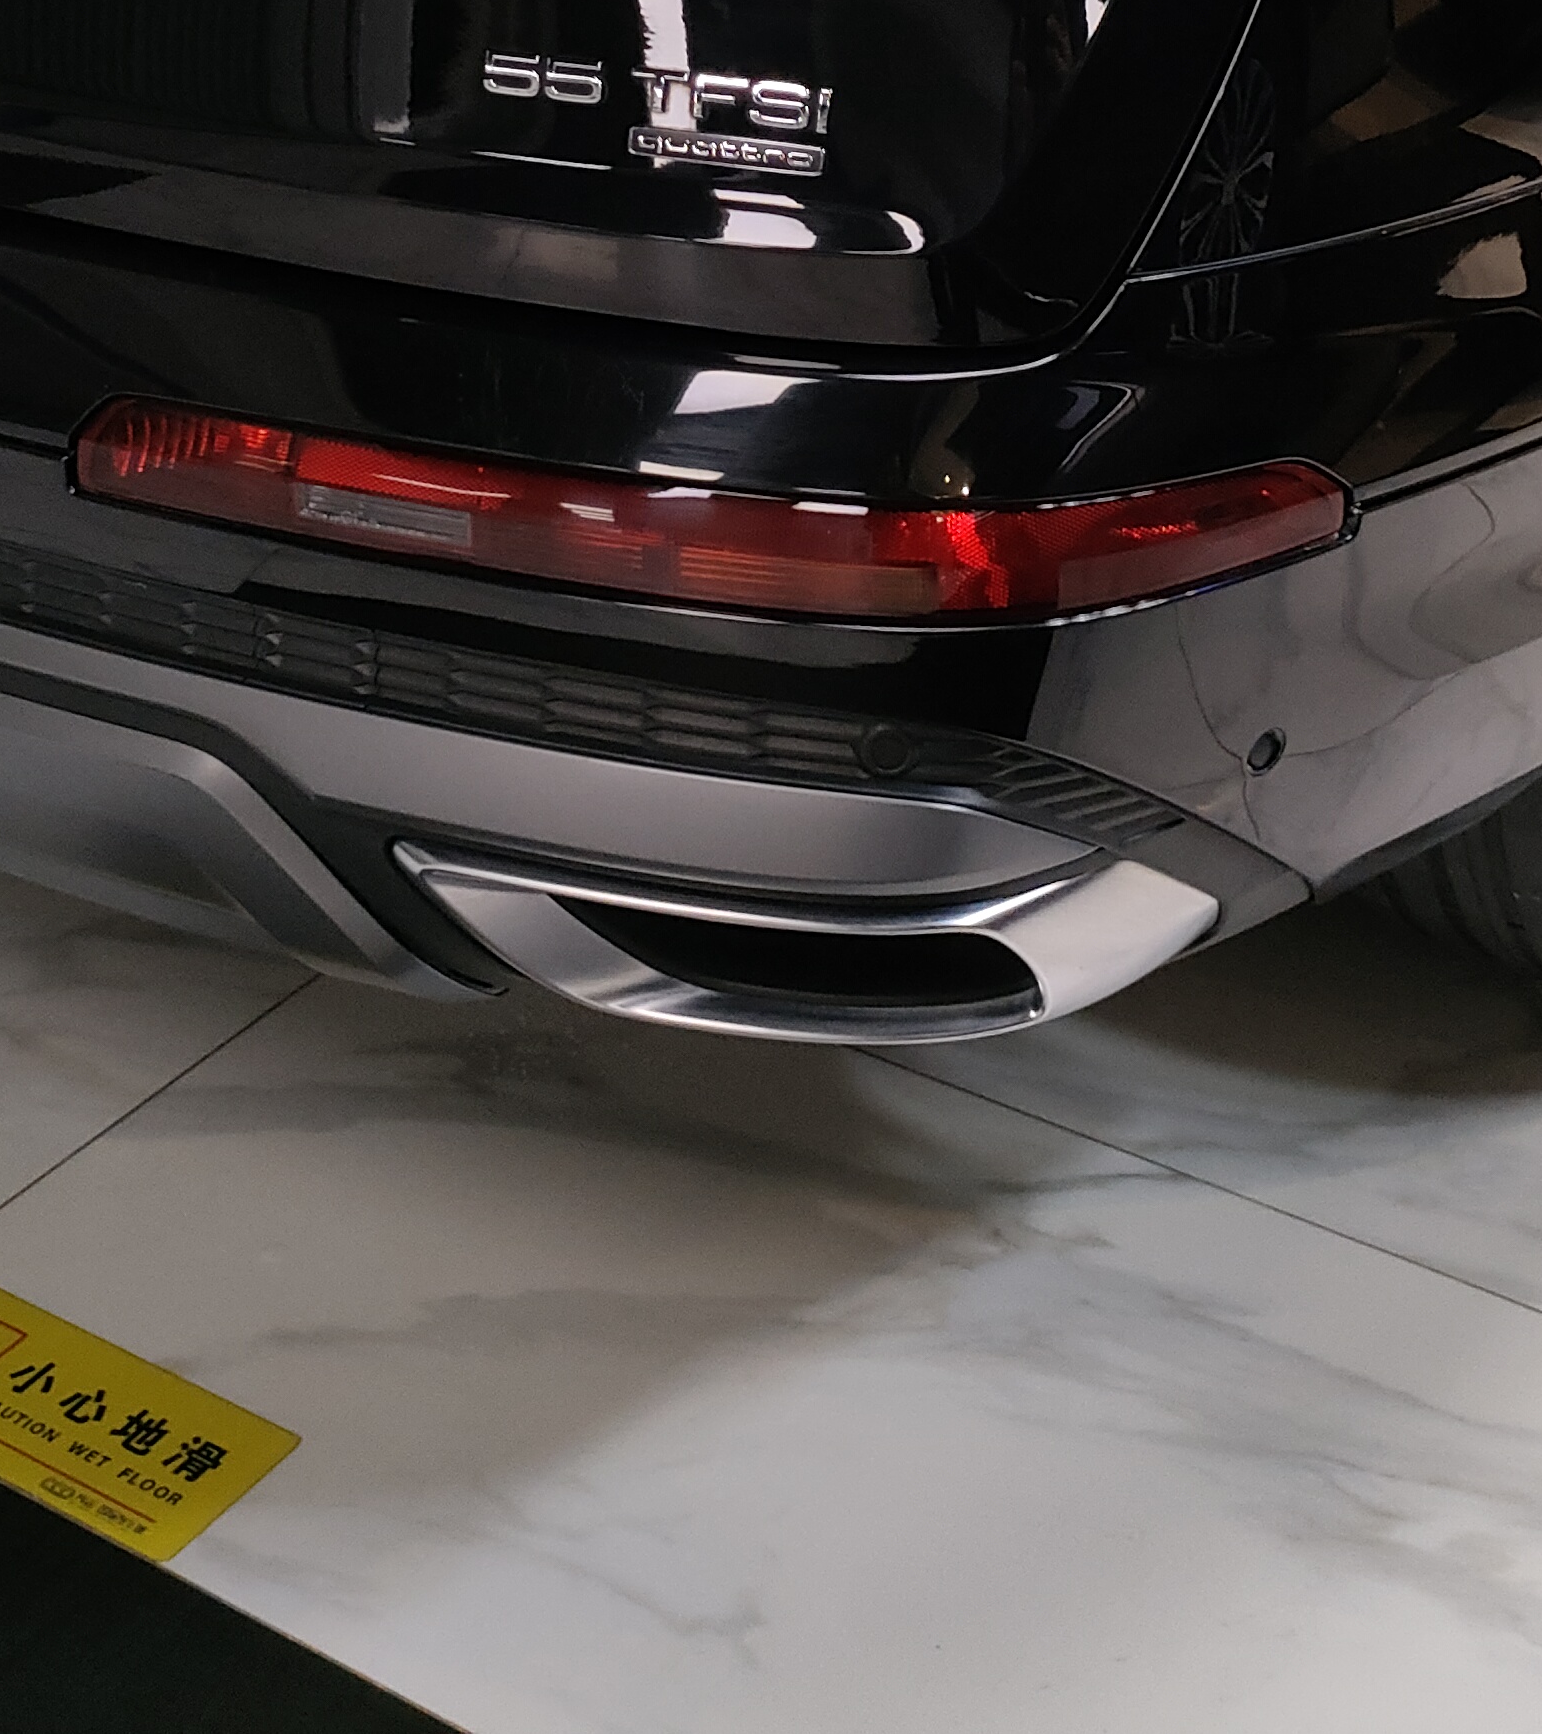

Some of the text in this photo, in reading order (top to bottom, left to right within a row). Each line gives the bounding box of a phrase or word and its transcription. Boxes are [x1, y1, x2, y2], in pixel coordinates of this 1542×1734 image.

[483, 48, 834, 135] 55 TFSI
[636, 133, 814, 168] quattro
[10, 1361, 229, 1483] 小心地滑
[68, 1440, 113, 1468] WET
[116, 1466, 184, 1506] FLOOR
